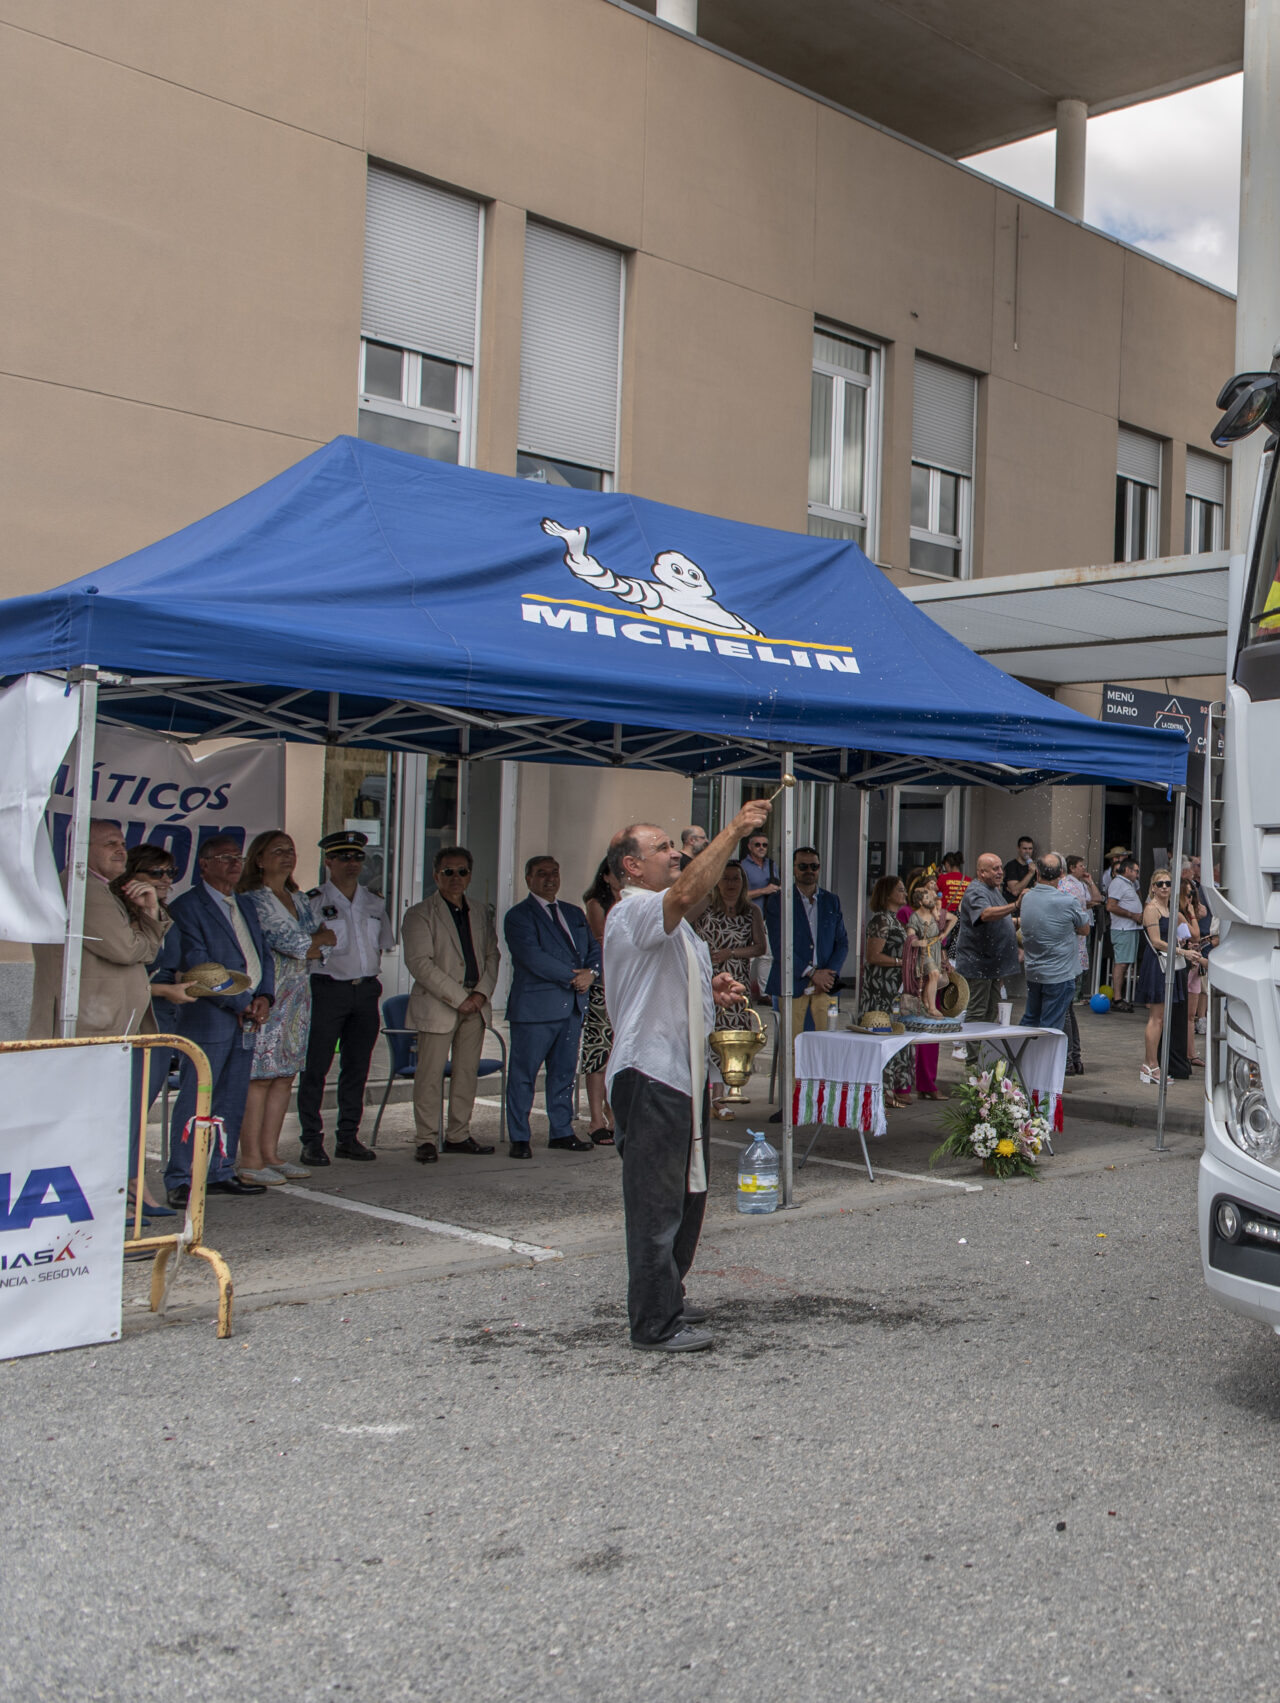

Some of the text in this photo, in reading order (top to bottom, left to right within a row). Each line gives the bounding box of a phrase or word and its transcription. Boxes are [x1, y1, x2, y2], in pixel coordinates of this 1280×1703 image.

[521, 603, 861, 674] MICHELIN
[1107, 690, 1135, 703] MENÚ
[1106, 704, 1138, 717] DIARIO
[38, 1266, 90, 1283] SEGOVIA
